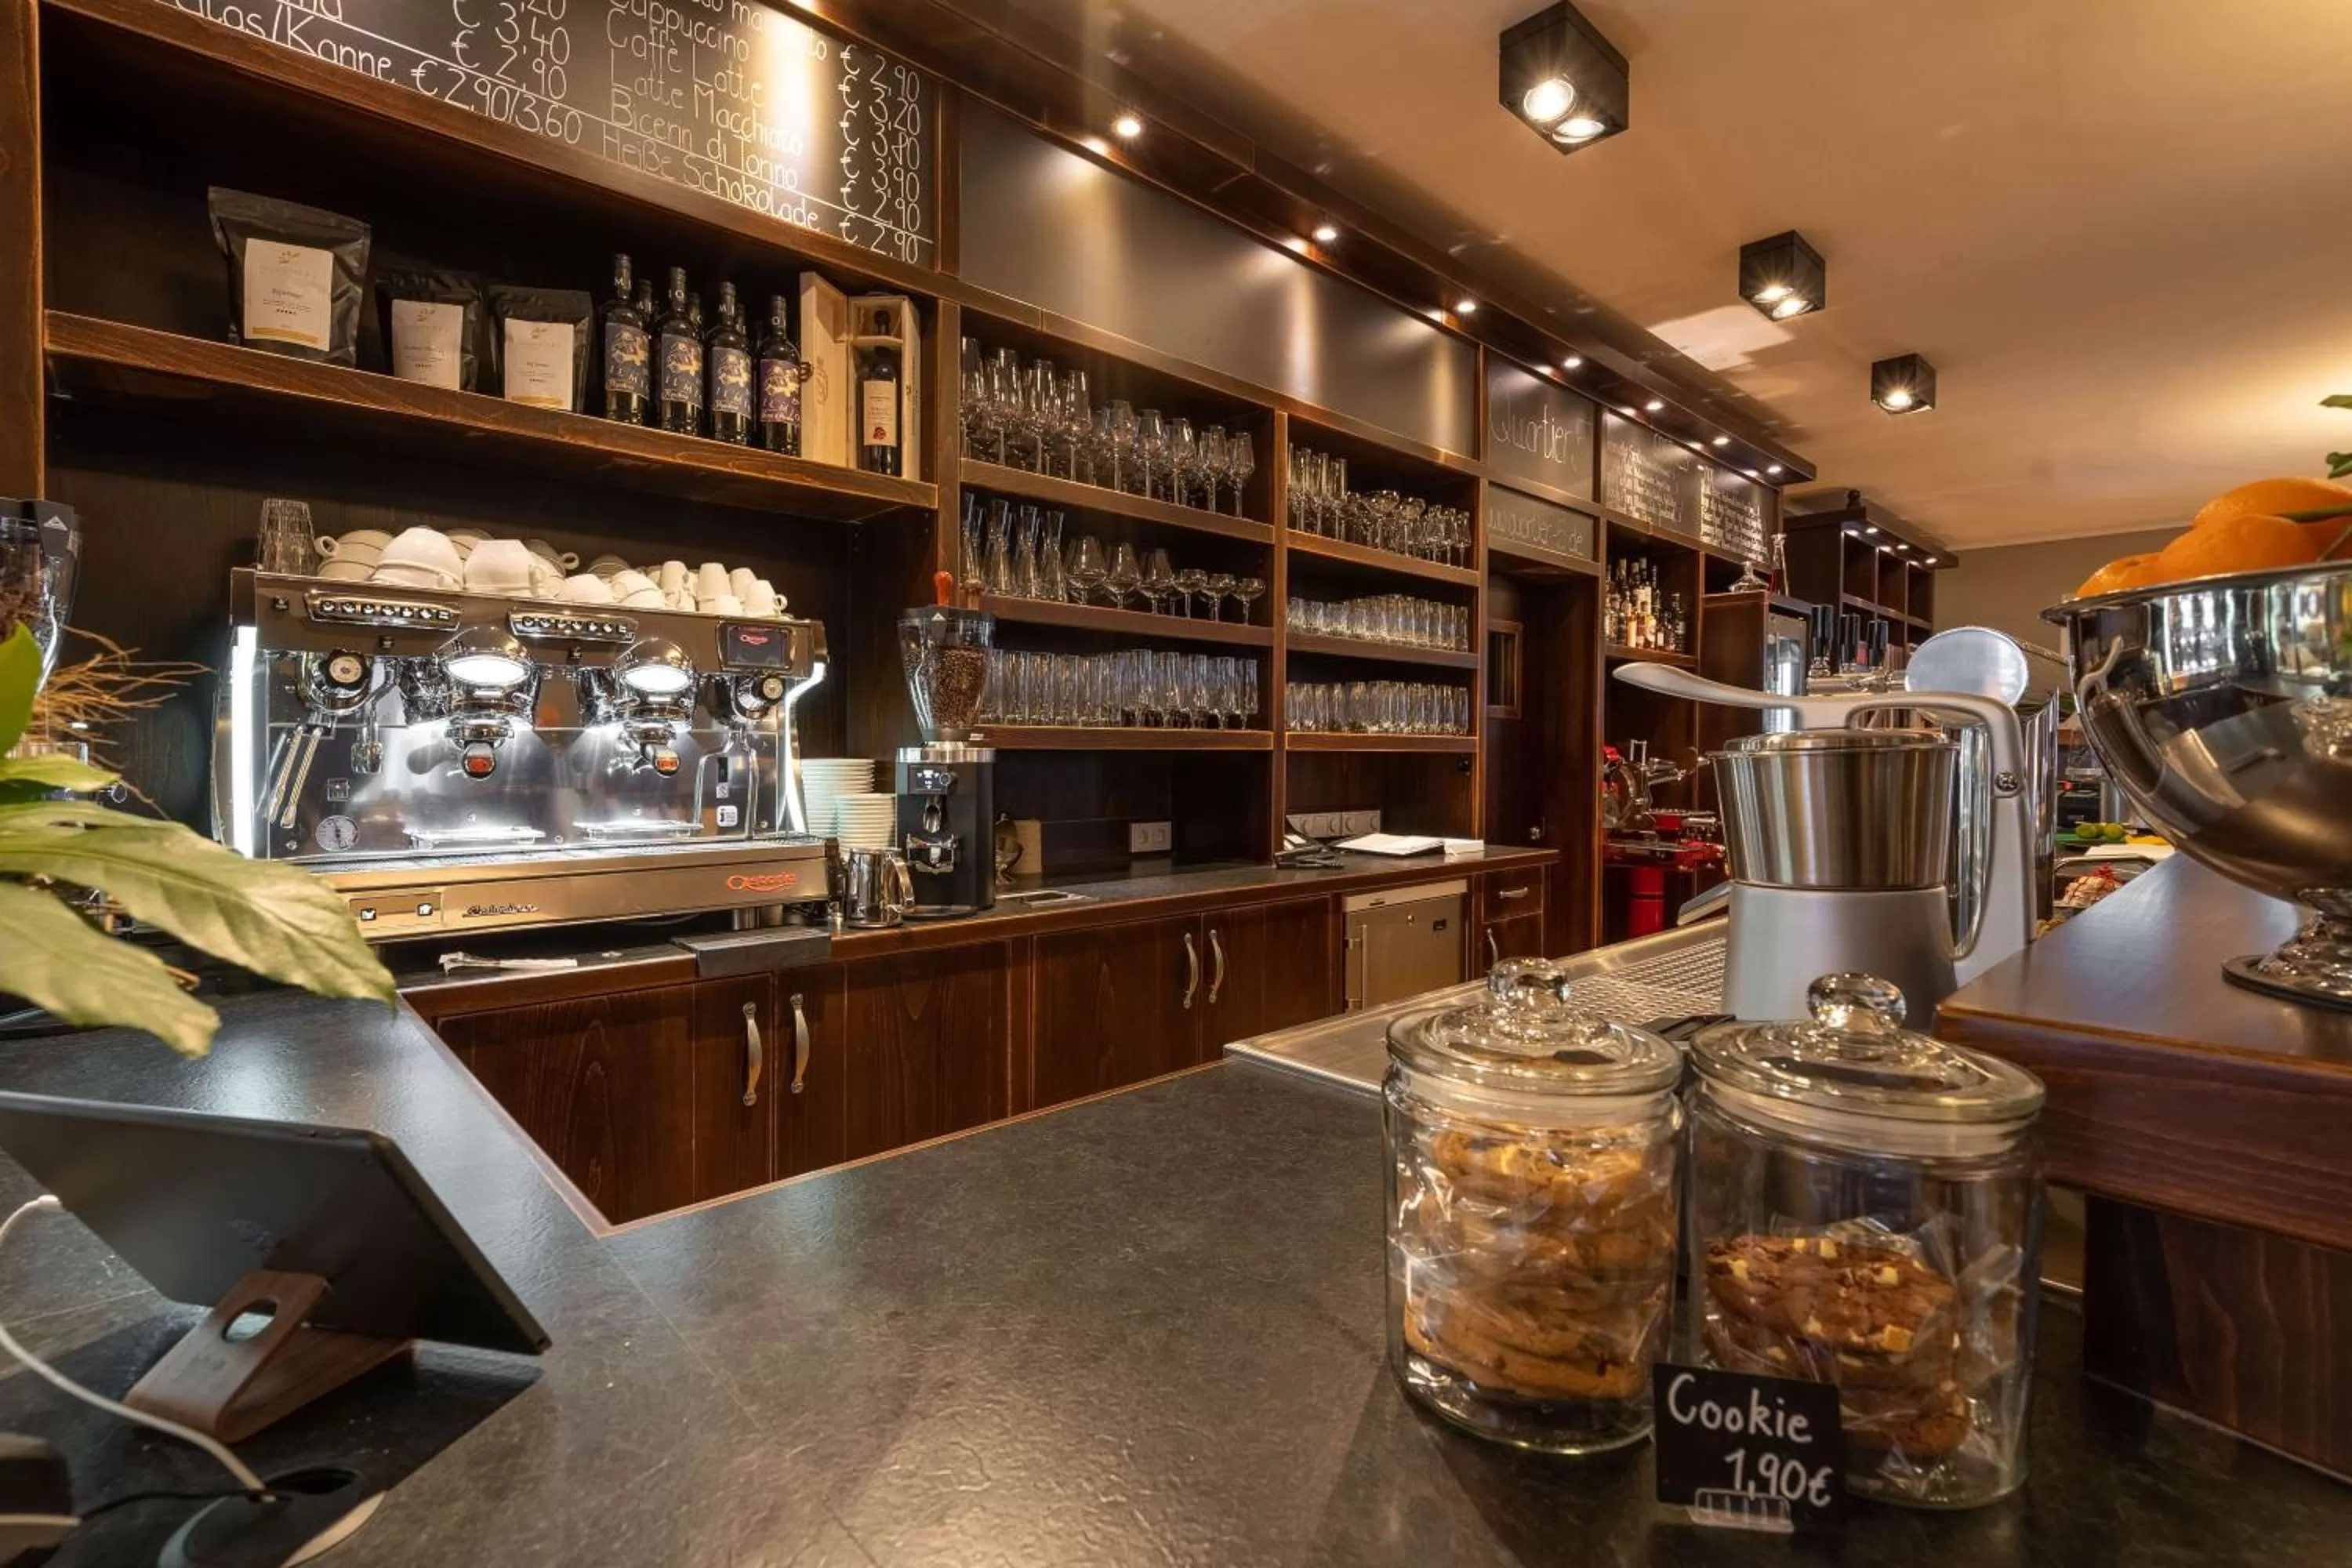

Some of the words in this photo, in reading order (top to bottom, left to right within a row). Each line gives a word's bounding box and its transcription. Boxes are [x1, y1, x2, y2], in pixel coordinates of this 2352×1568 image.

[451, 30, 480, 68] €
[495, 45, 566, 100] 2,90
[495, 2, 570, 65] 3,40
[609, 0, 750, 62] appuccino
[837, 74, 860, 109] €
[869, 86, 920, 136] 3,20
[606, 8, 683, 74] Caffè
[692, 43, 766, 107] Latte
[839, 109, 860, 146] €
[869, 54, 919, 102] 2,90
[611, 47, 685, 108] Latte
[840, 147, 860, 179] €
[872, 158, 920, 202] 3,90
[706, 129, 727, 165] di
[731, 133, 798, 189] Torino
[683, 154, 821, 231] Schokolade
[870, 223, 918, 264] 2,90
[1668, 1374, 1813, 1443] Cookie
[1723, 1449, 1834, 1507] 1,90€
